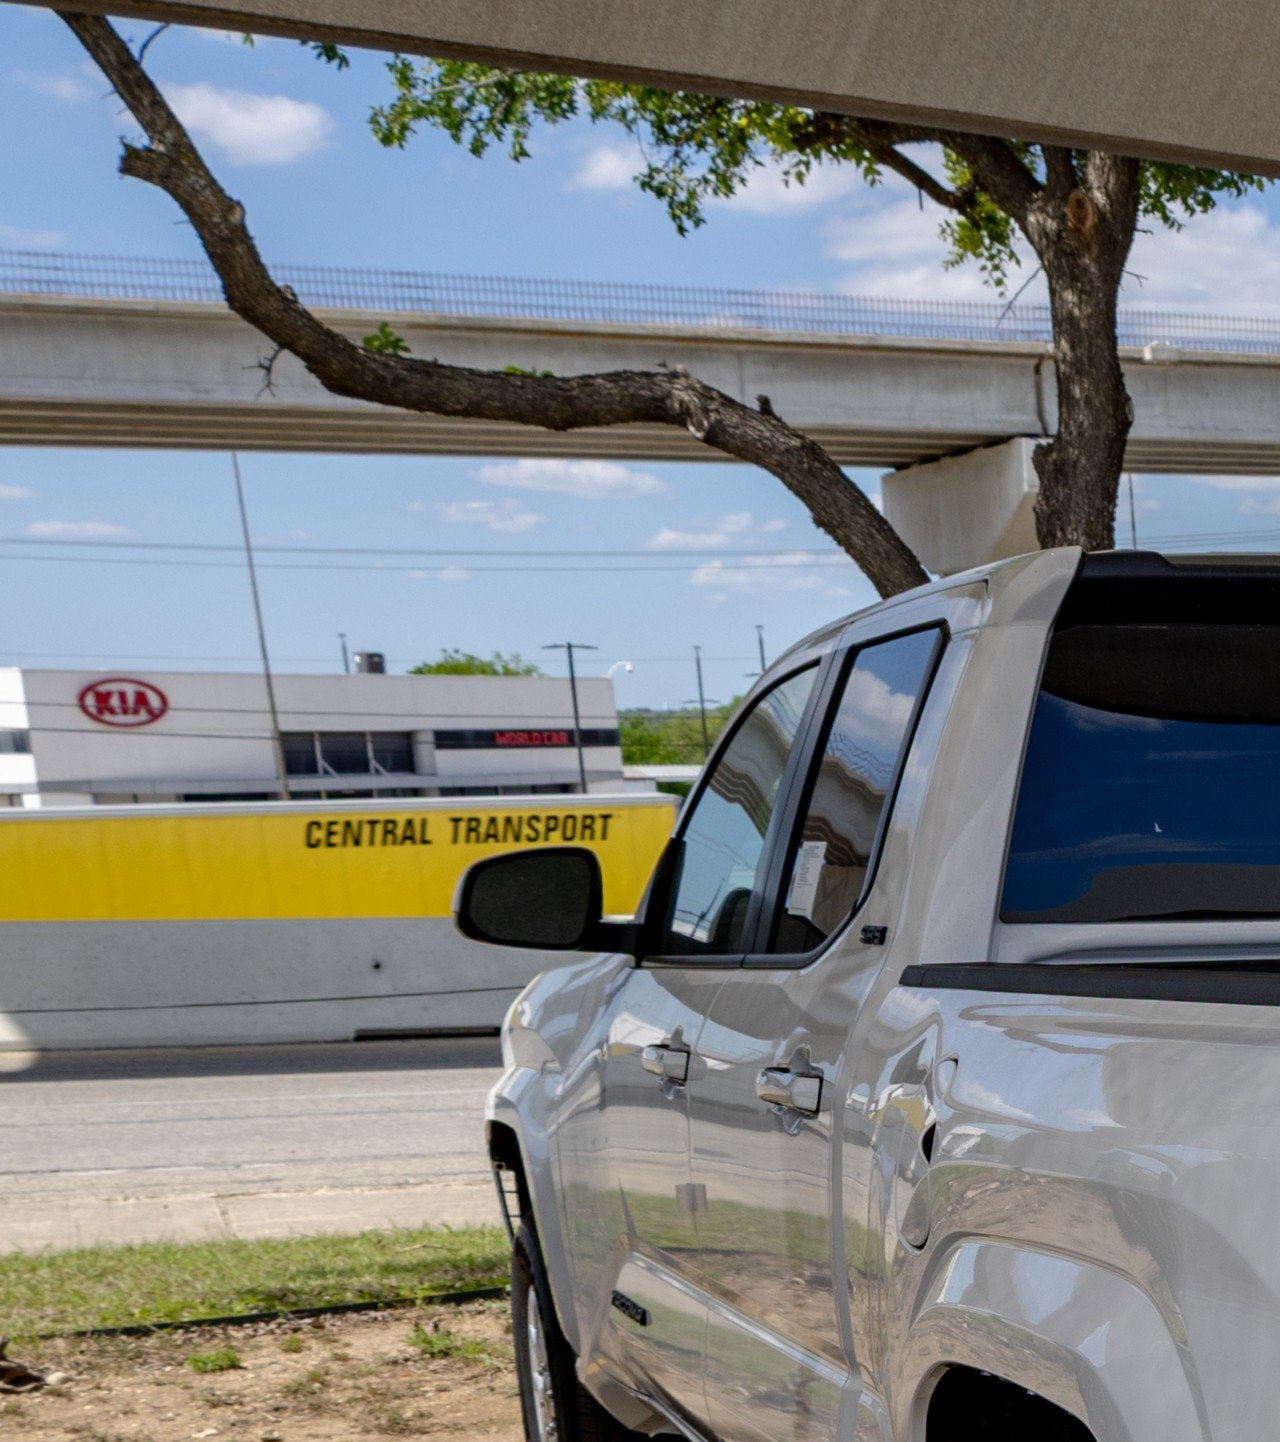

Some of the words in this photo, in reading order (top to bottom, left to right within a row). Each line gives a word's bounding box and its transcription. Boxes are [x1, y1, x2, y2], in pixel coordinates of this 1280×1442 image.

[92, 689, 157, 717] KIA
[494, 731, 542, 746] WORLD
[544, 731, 569, 745] CAR
[304, 817, 433, 850] CENTRAL
[449, 813, 613, 846] TRANSPORT
